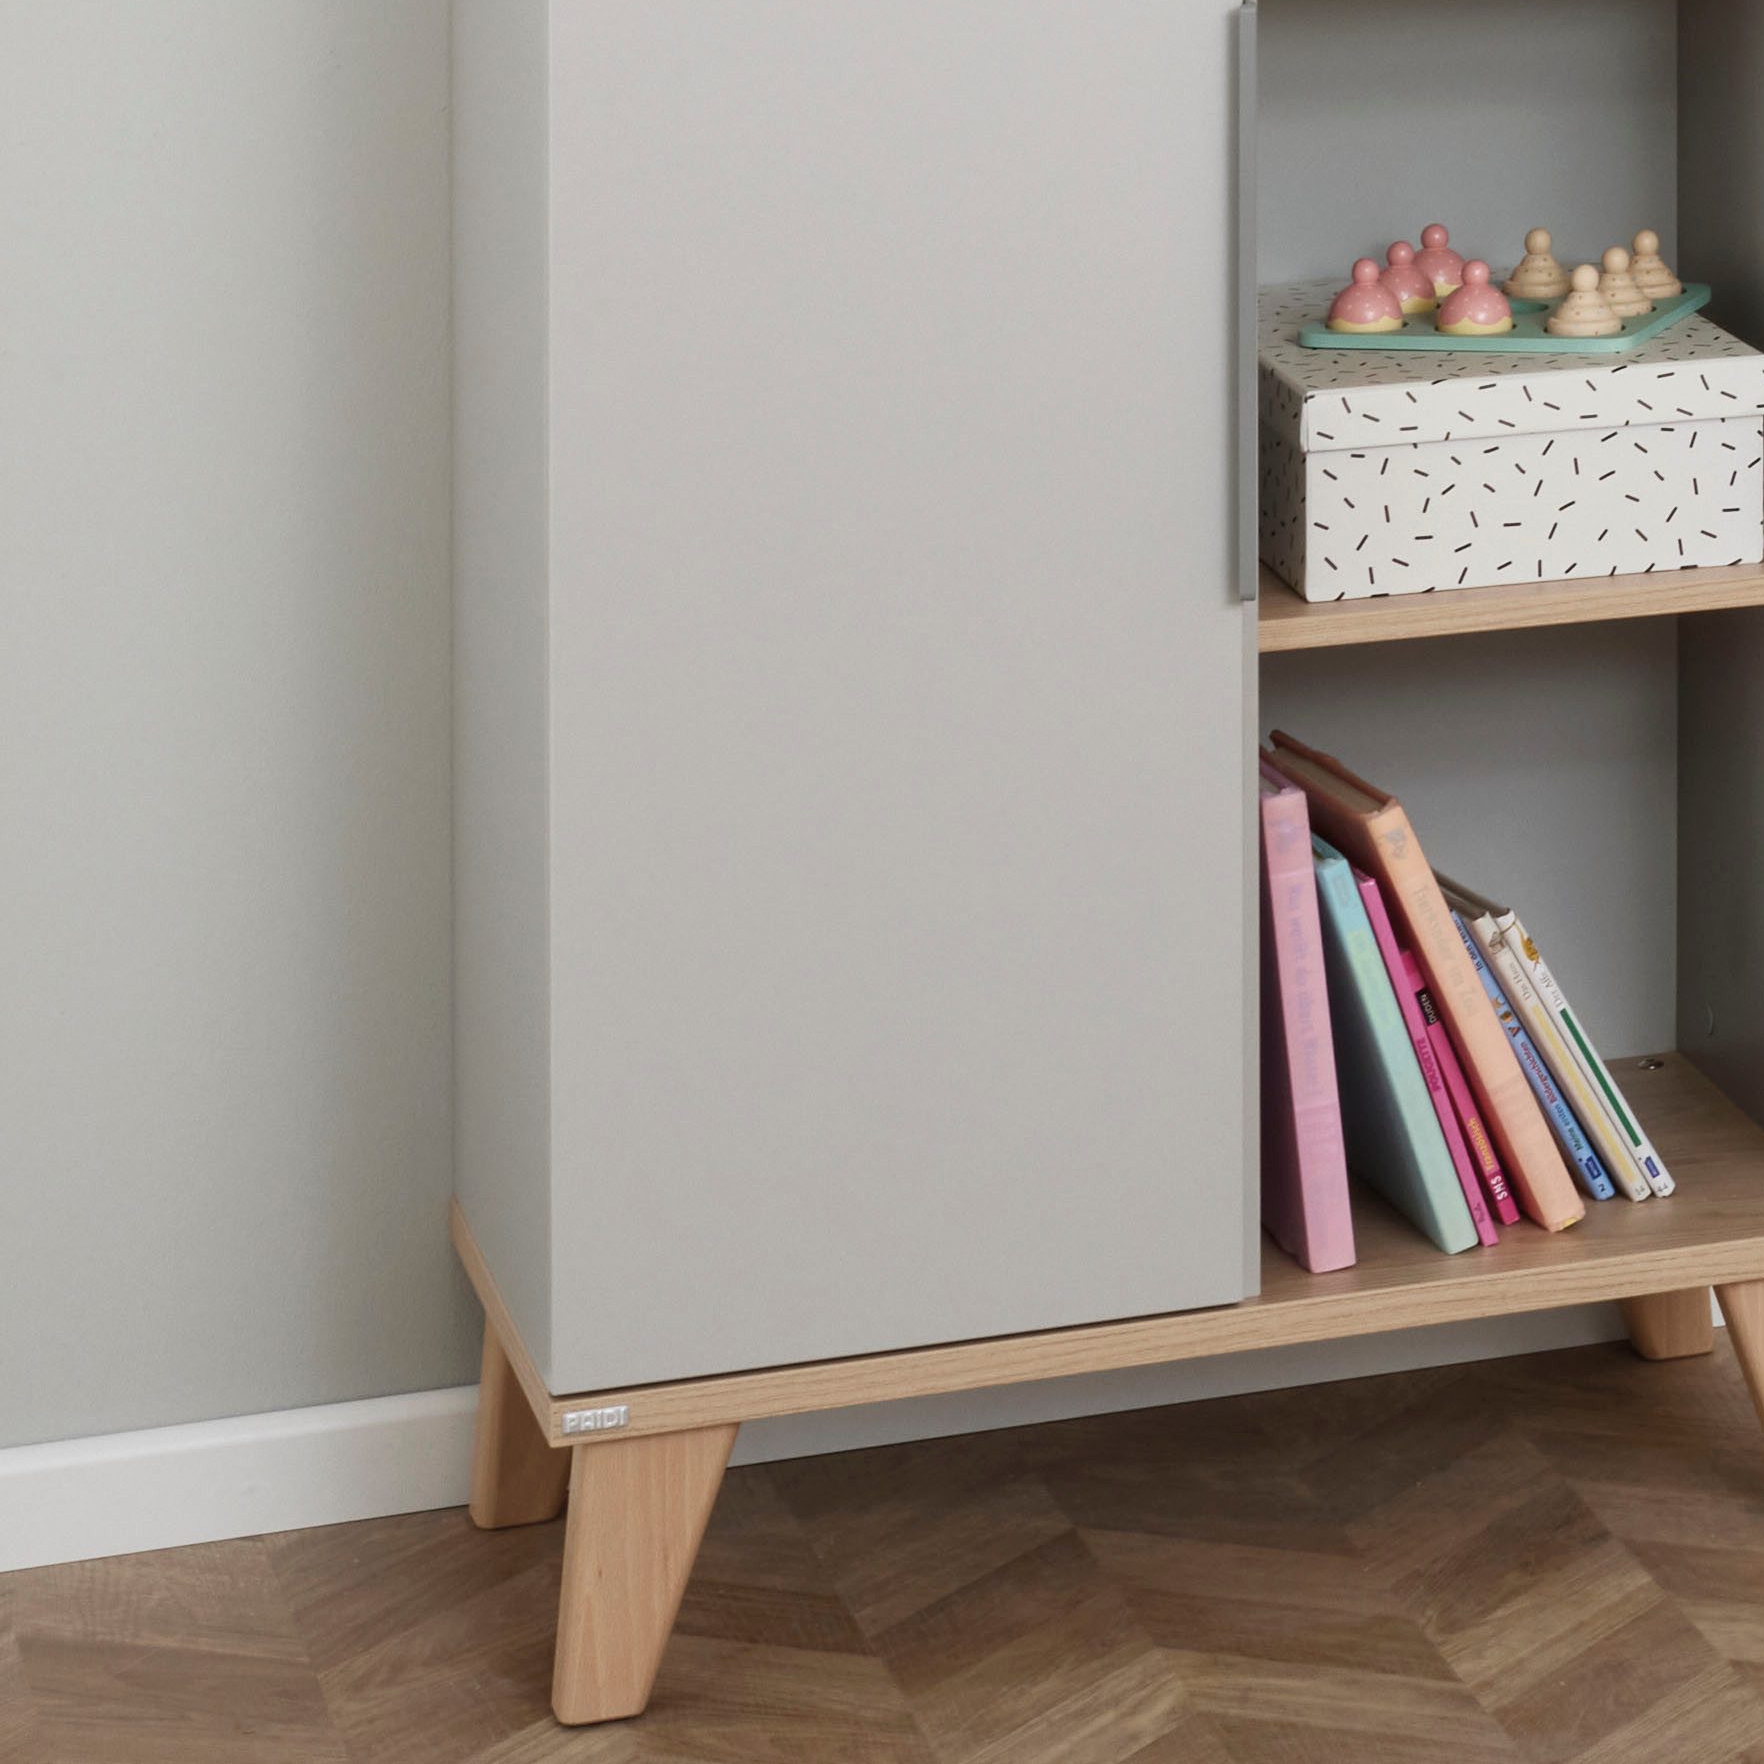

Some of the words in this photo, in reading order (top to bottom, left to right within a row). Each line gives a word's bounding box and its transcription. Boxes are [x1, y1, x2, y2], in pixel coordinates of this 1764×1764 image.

[1419, 993, 1438, 1024] DUDEN
[1554, 1103, 1570, 1126] ersten
[1566, 1127, 1583, 1150] Meine
[1489, 1174, 1509, 1200] SMS
